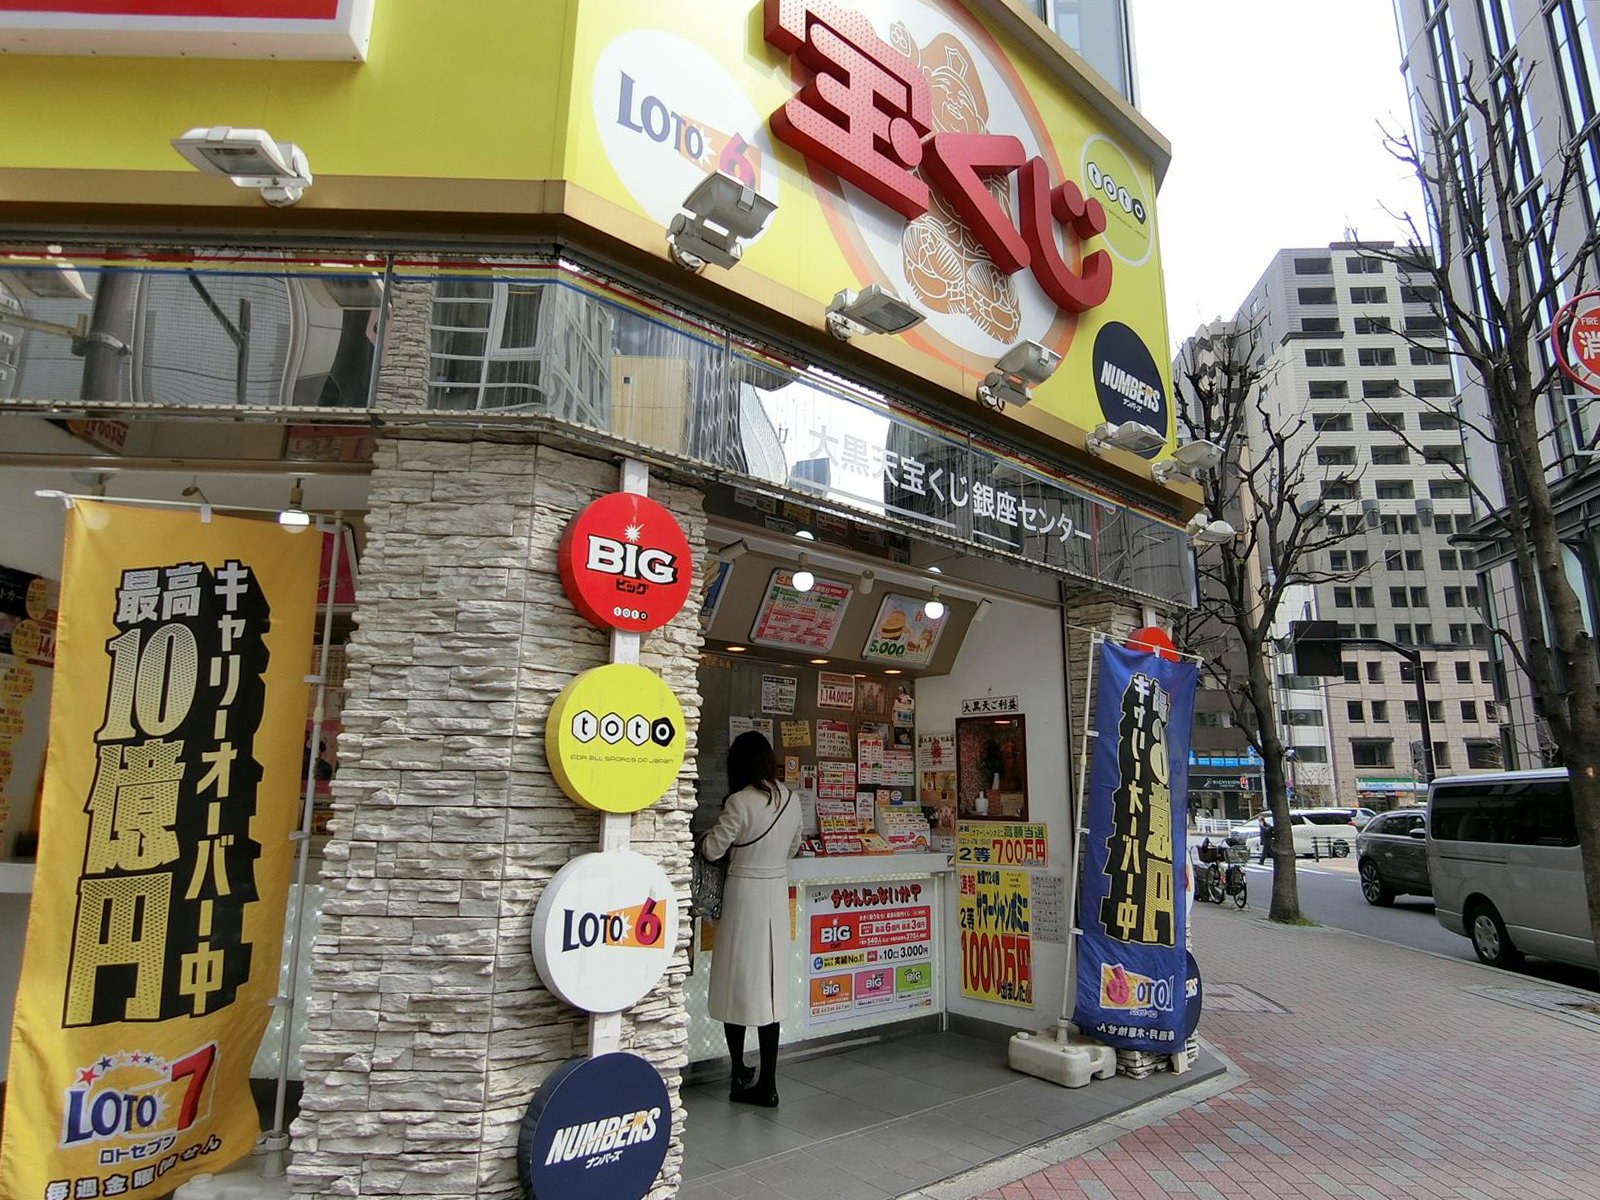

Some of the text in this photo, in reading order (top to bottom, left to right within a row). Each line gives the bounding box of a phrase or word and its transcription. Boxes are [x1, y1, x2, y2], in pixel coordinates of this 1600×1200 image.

[617, 70, 756, 191] LOTO 6
[764, 0, 1112, 313] 宝くじ
[1086, 162, 1147, 225] toto
[1100, 360, 1161, 413] NUMBERS
[586, 533, 678, 585] BIG
[616, 578, 648, 595] ビッグ
[613, 606, 647, 621] toto
[963, 698, 1017, 713] 大黒天ご利益
[571, 709, 676, 747] toto
[179, 562, 249, 1016] キャリーオーバー中
[1004, 825, 1044, 838] 高額当選
[959, 838, 1046, 864] 2等 700万円
[561, 896, 662, 952] LOTO 6
[820, 925, 852, 944] BIG
[960, 907, 975, 930] 2等
[866, 976, 882, 988] BIG
[961, 930, 1032, 1003] 1000万円
[823, 983, 840, 995] BIG
[65, 1043, 217, 1144] LOTO 7
[100, 1135, 176, 1164] ロトセブン
[545, 1106, 662, 1167] NUMBERS
[585, 1150, 623, 1169] ナンバーズ
